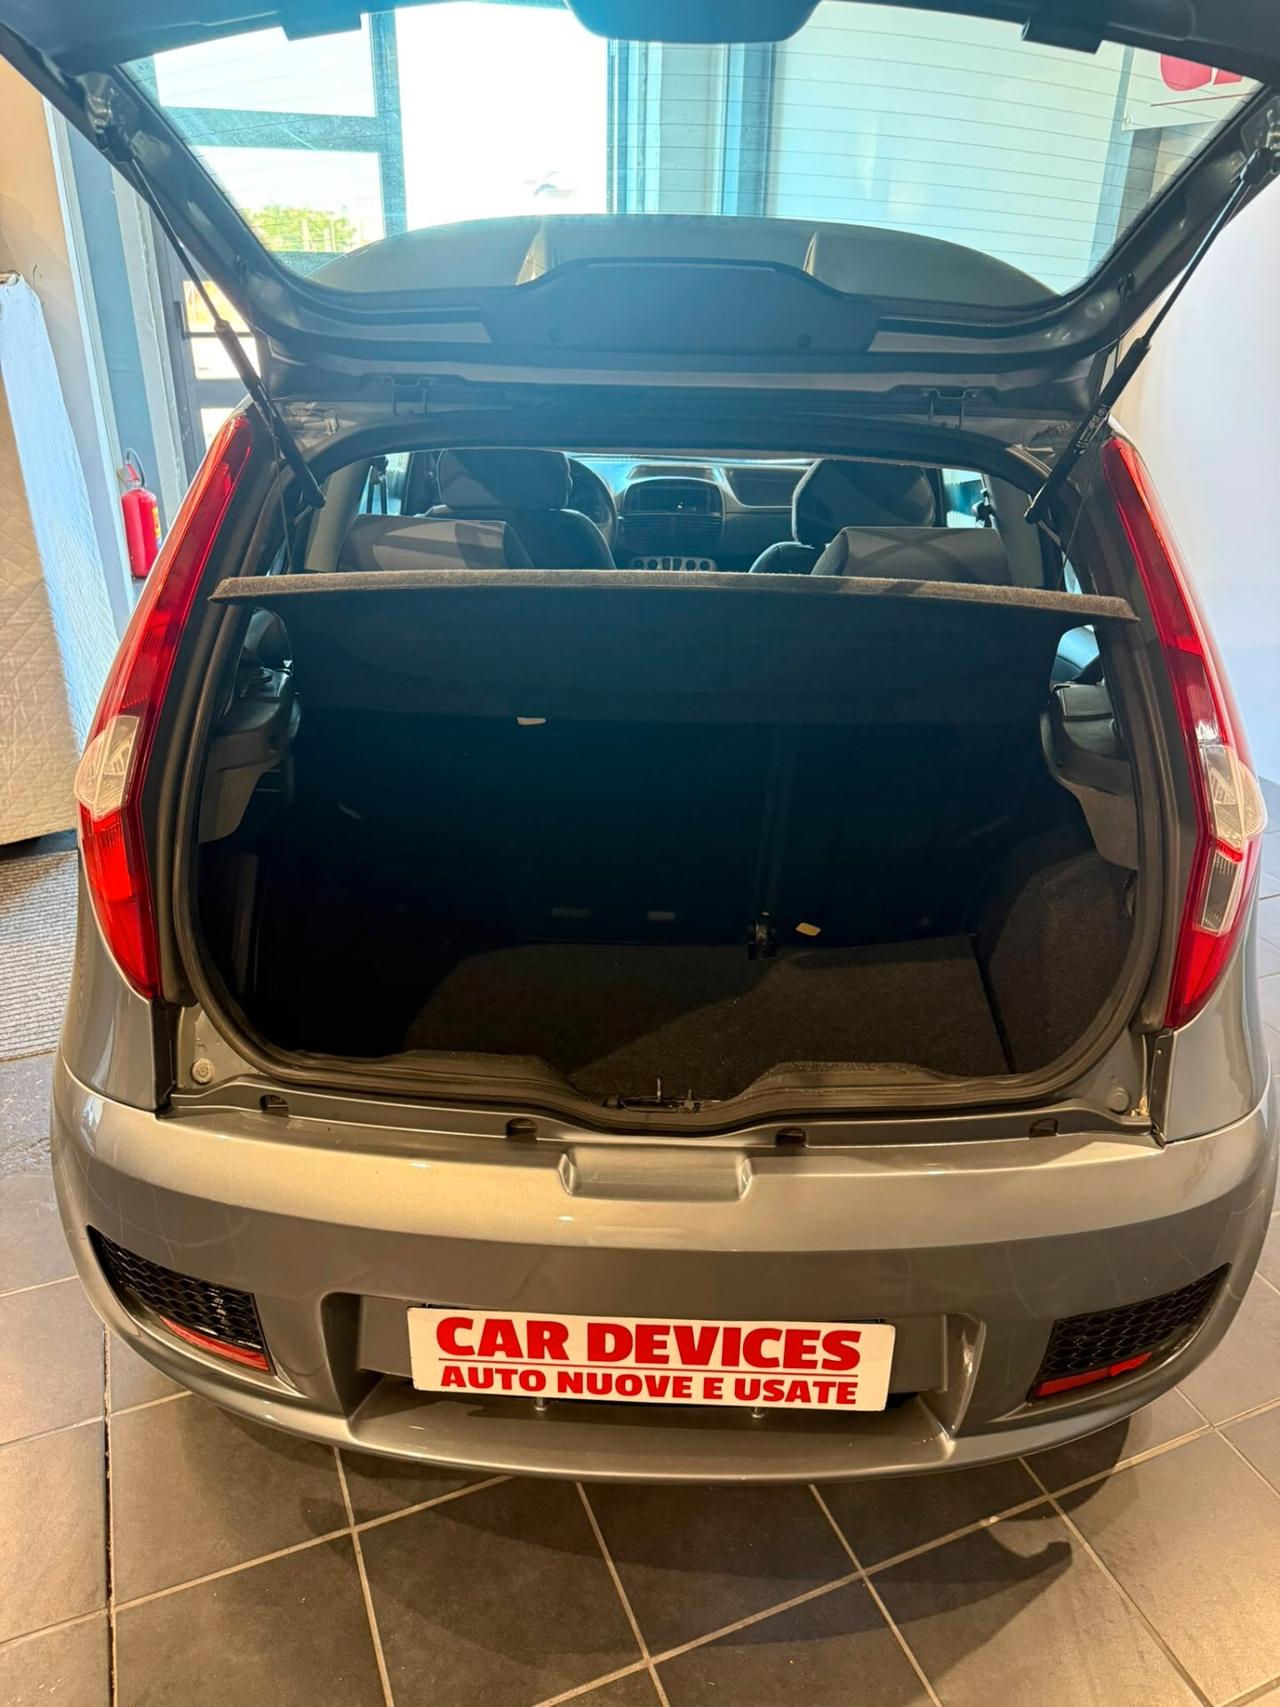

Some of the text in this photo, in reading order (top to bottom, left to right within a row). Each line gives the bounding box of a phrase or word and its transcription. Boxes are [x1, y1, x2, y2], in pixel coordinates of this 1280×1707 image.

[435, 1316, 862, 1372] CAR DEVICES
[440, 1365, 859, 1405] AUTO NUOVE E USATE
